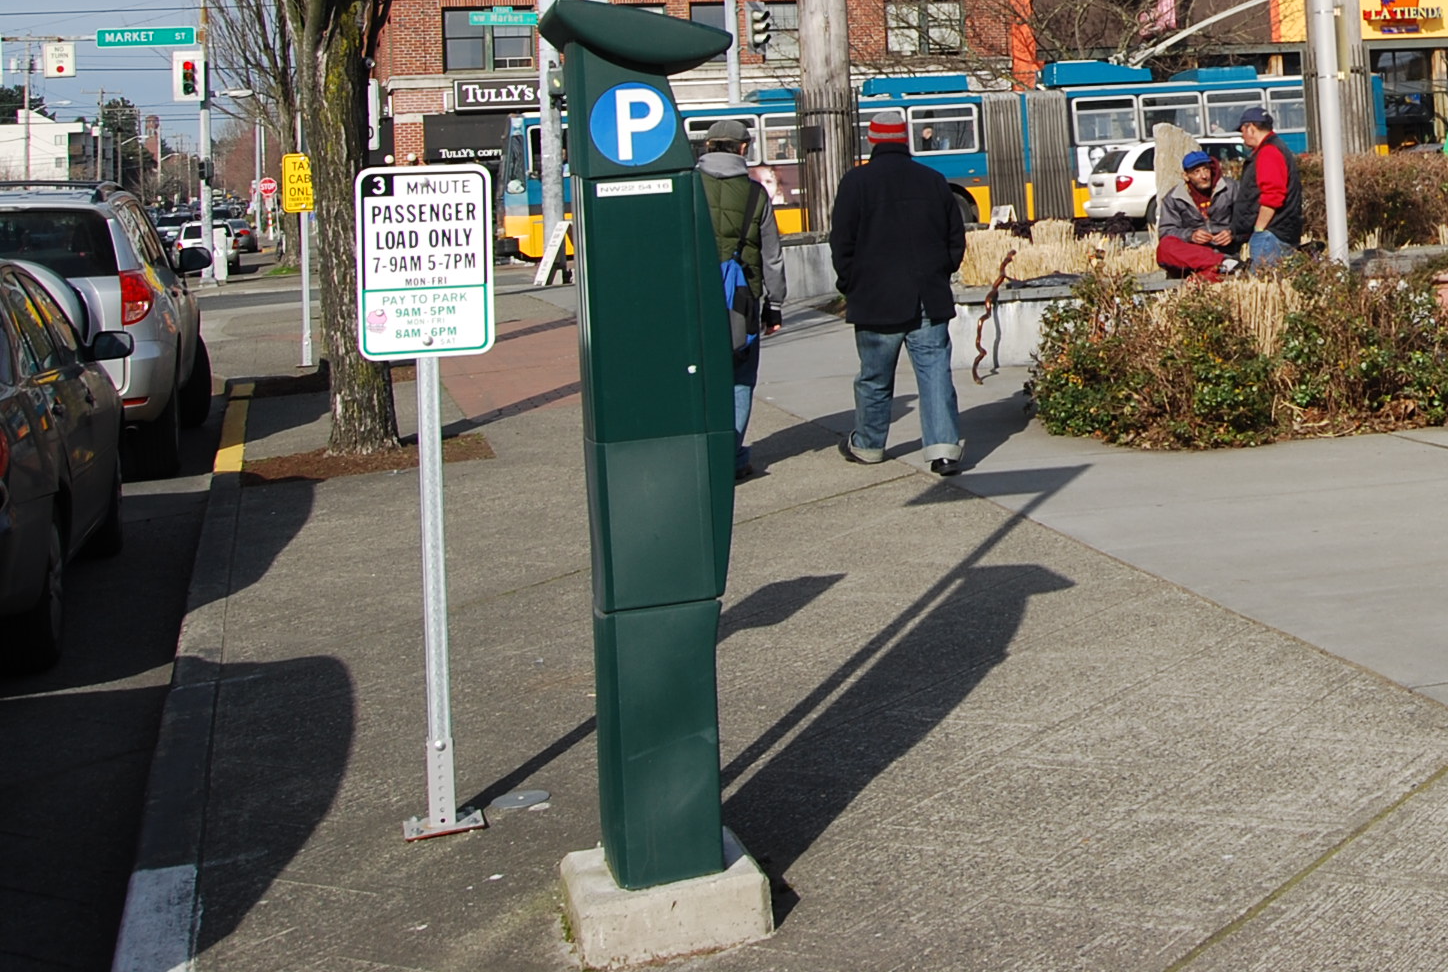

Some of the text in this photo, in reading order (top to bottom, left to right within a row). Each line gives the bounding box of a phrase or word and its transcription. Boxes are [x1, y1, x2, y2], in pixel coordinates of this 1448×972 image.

[490, 14, 523, 22] Market
[1370, 7, 1391, 20] LA
[104, 31, 186, 43] MARKET ST
[615, 88, 664, 161] P
[289, 186, 313, 197] ONL
[372, 176, 471, 195] 3 MINUTE
[371, 202, 477, 224] PASSENGER
[375, 228, 473, 250] LOAD ONLY
[373, 252, 476, 273] 7-9AM 5-7PM
[405, 276, 448, 286] MON-FRI
[382, 292, 468, 306] PAY TO PARK
[440, 337, 456, 345] SAT
